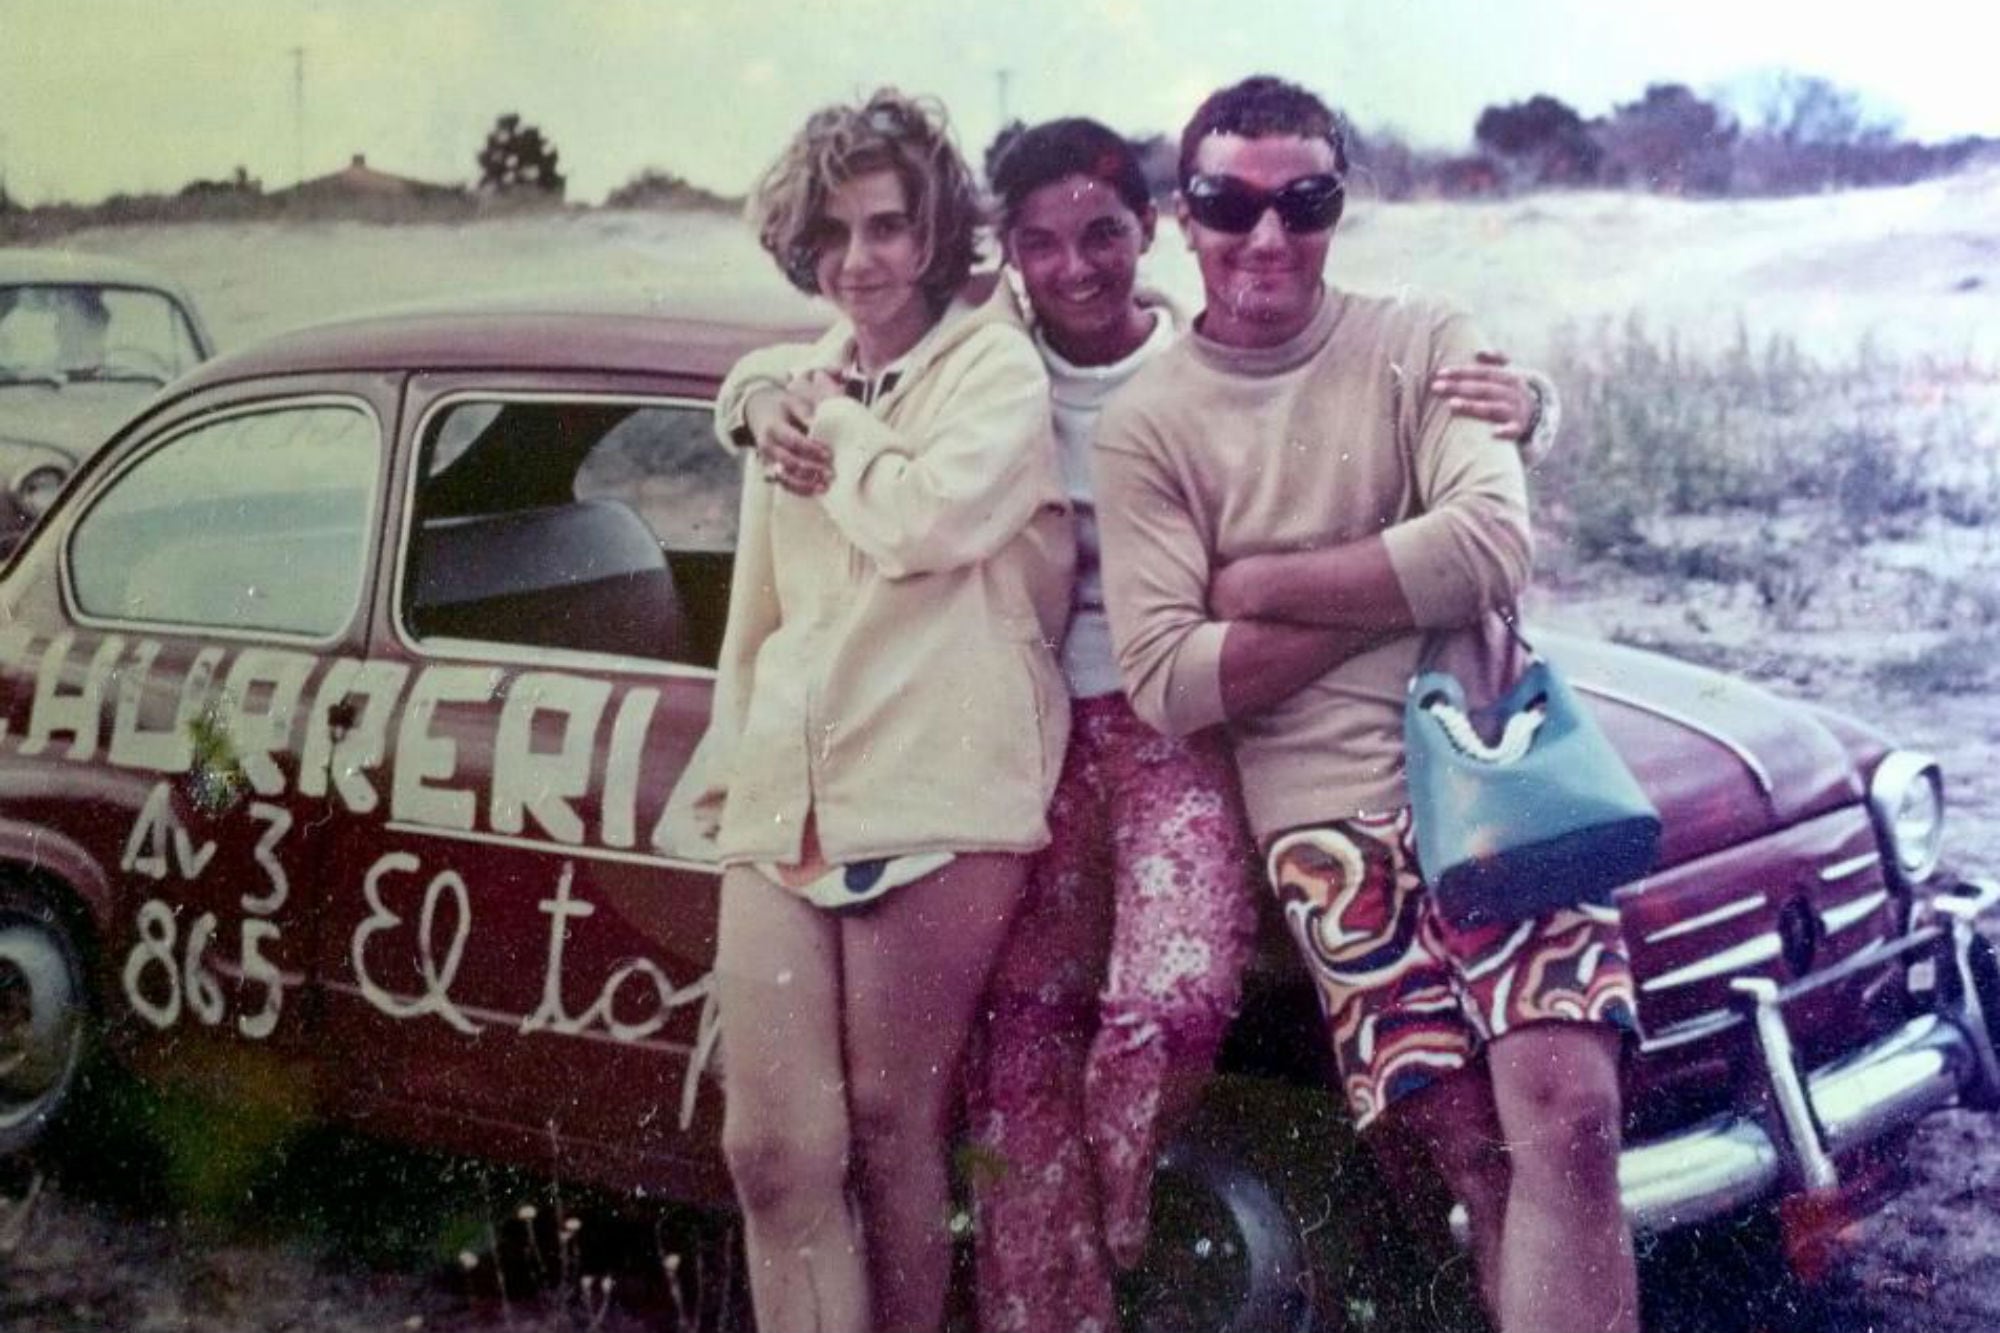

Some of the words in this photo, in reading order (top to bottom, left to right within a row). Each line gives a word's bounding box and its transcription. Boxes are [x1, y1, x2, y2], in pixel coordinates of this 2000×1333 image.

[241, 801, 293, 914] 3
[122, 899, 282, 1038] 865
[352, 851, 483, 1035] El
